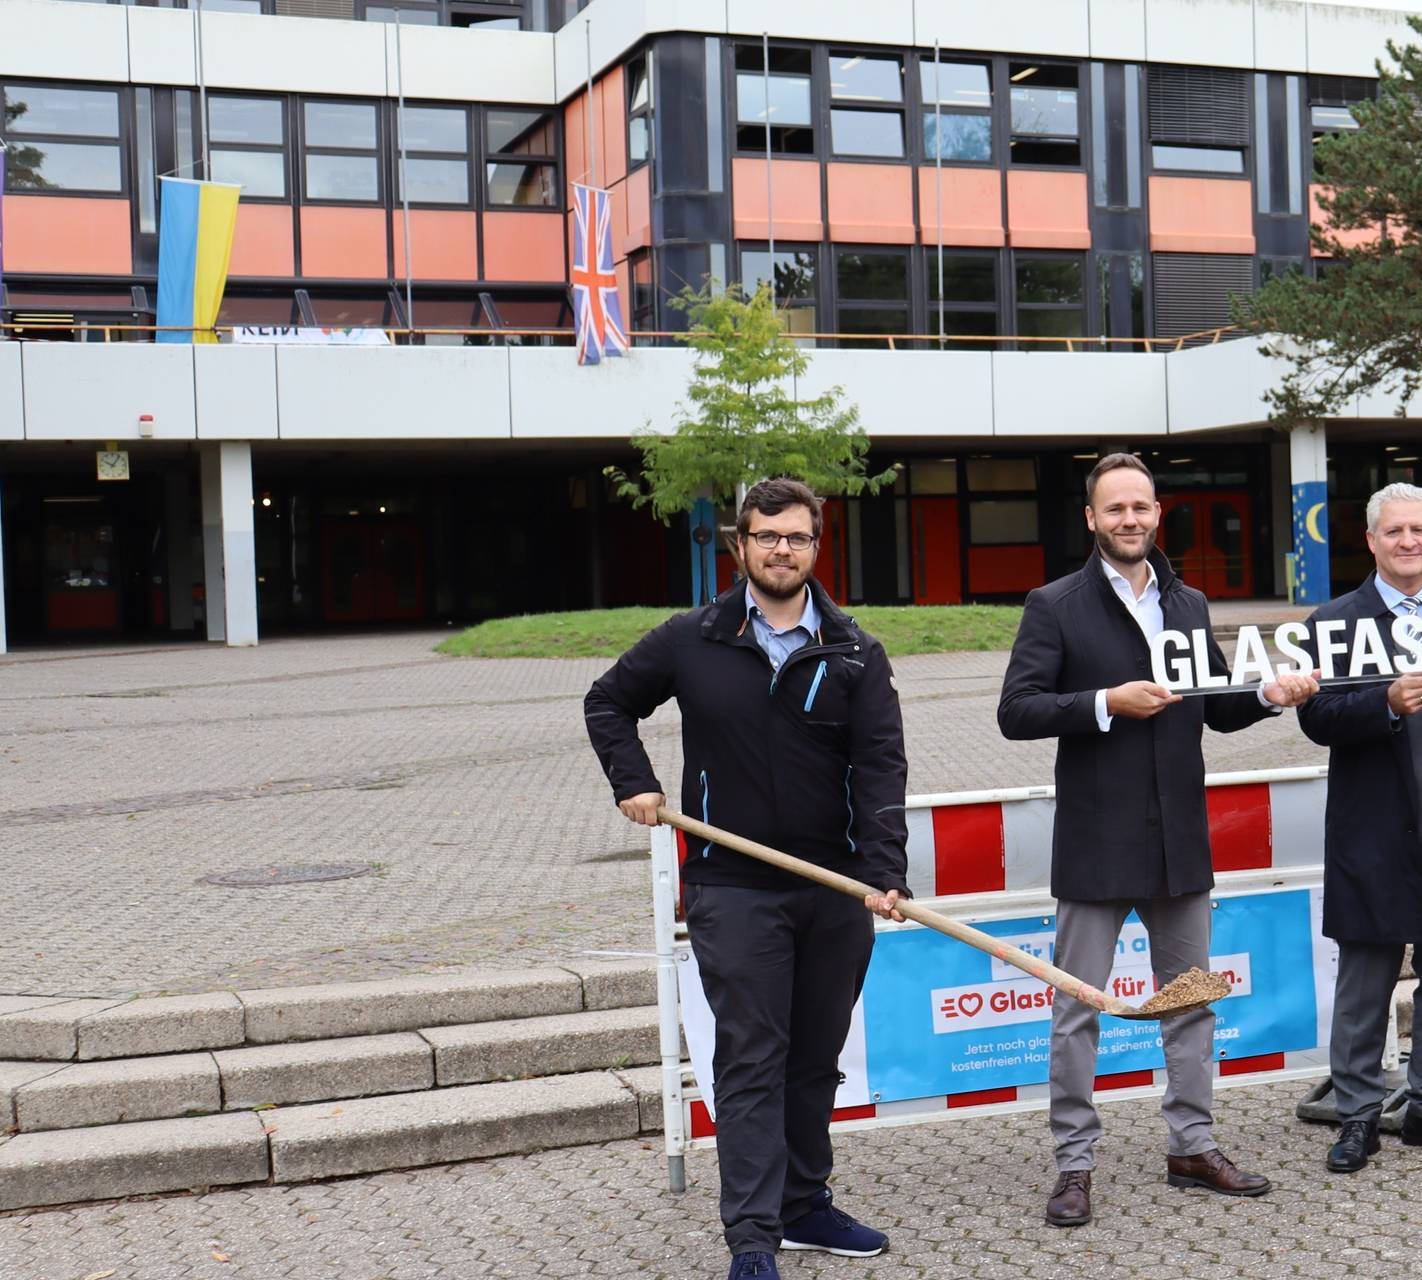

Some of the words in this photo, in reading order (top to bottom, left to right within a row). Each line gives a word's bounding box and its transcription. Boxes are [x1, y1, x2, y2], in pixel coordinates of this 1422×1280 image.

[989, 984, 1055, 1013] Glasf
[1112, 975, 1146, 998] für
[951, 1055, 1022, 1073] kostenfreien
[1111, 1040, 1153, 1054] sichern:
[964, 1043, 994, 1056] Jetzt
[996, 1038, 1025, 1052] noch
